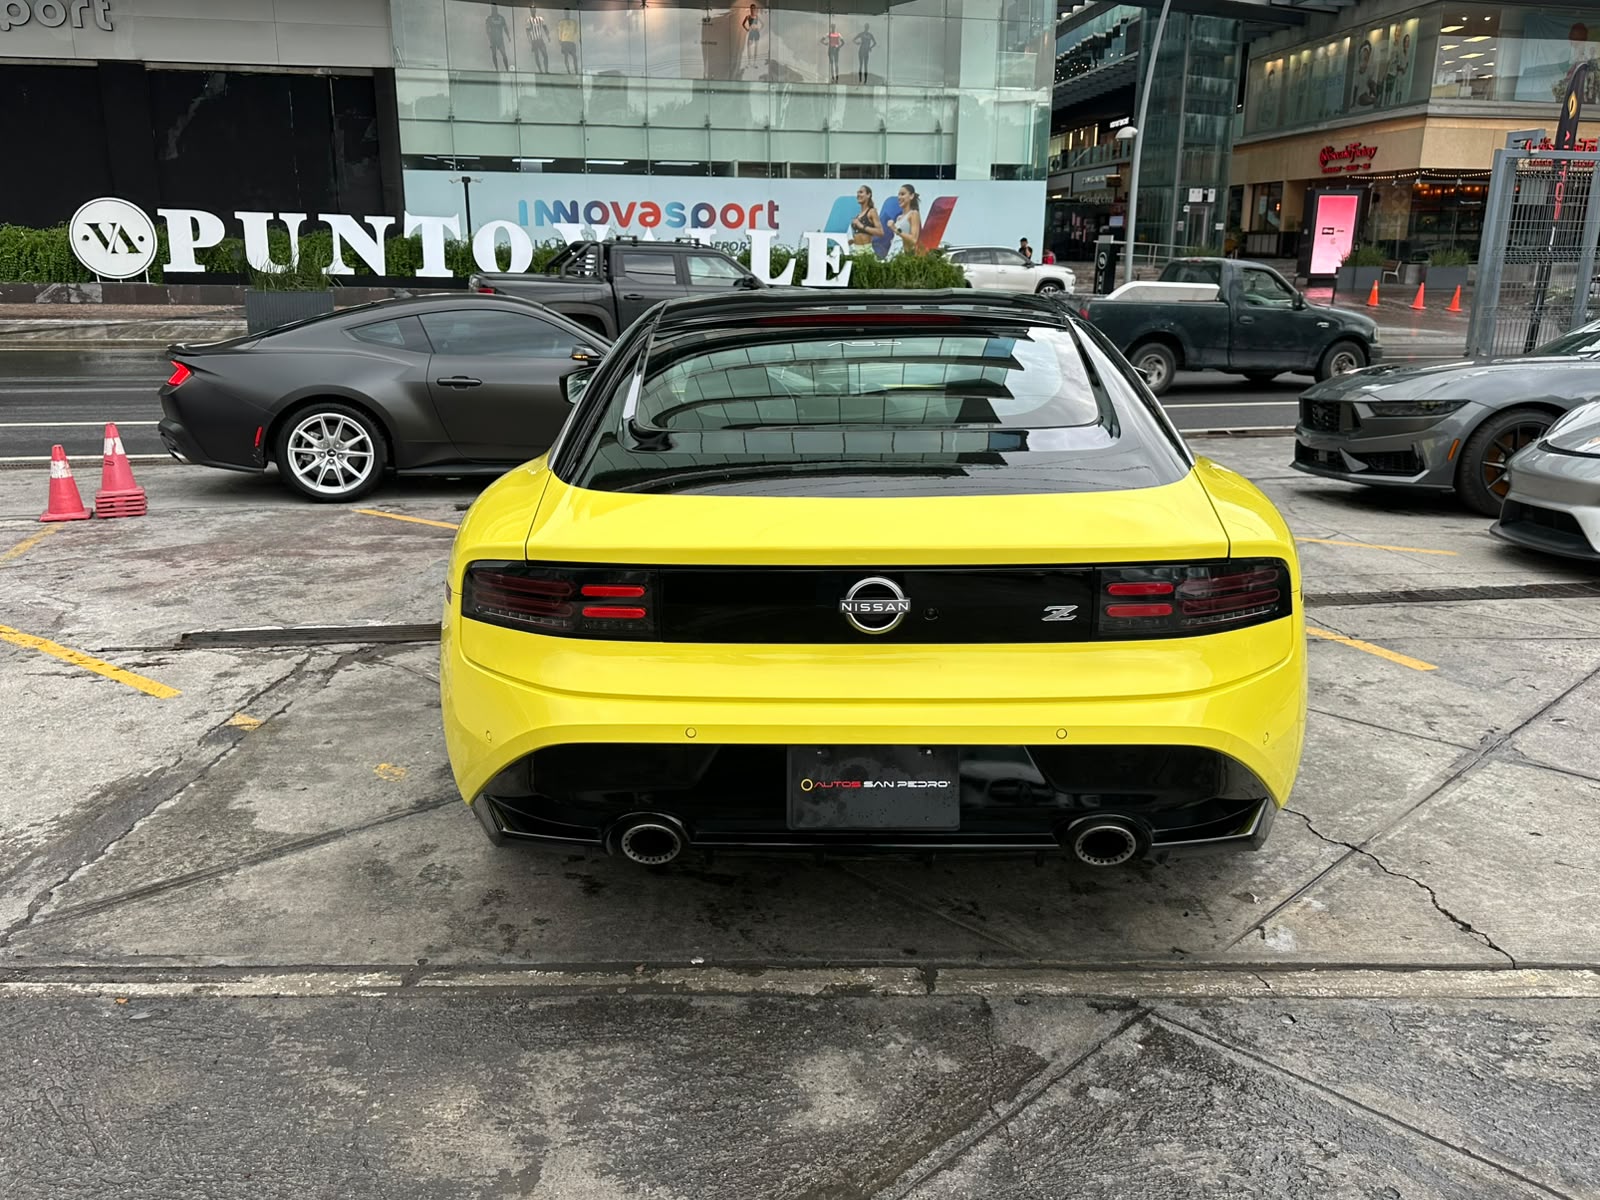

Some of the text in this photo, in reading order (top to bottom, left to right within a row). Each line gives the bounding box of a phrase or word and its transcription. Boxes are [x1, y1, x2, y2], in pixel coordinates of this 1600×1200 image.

[157, 208, 533, 278] PUNTO
[841, 602, 909, 612] NISSAN
[1041, 604, 1079, 622] Z
[814, 780, 948, 788] AUTOS SAN PEDRO
